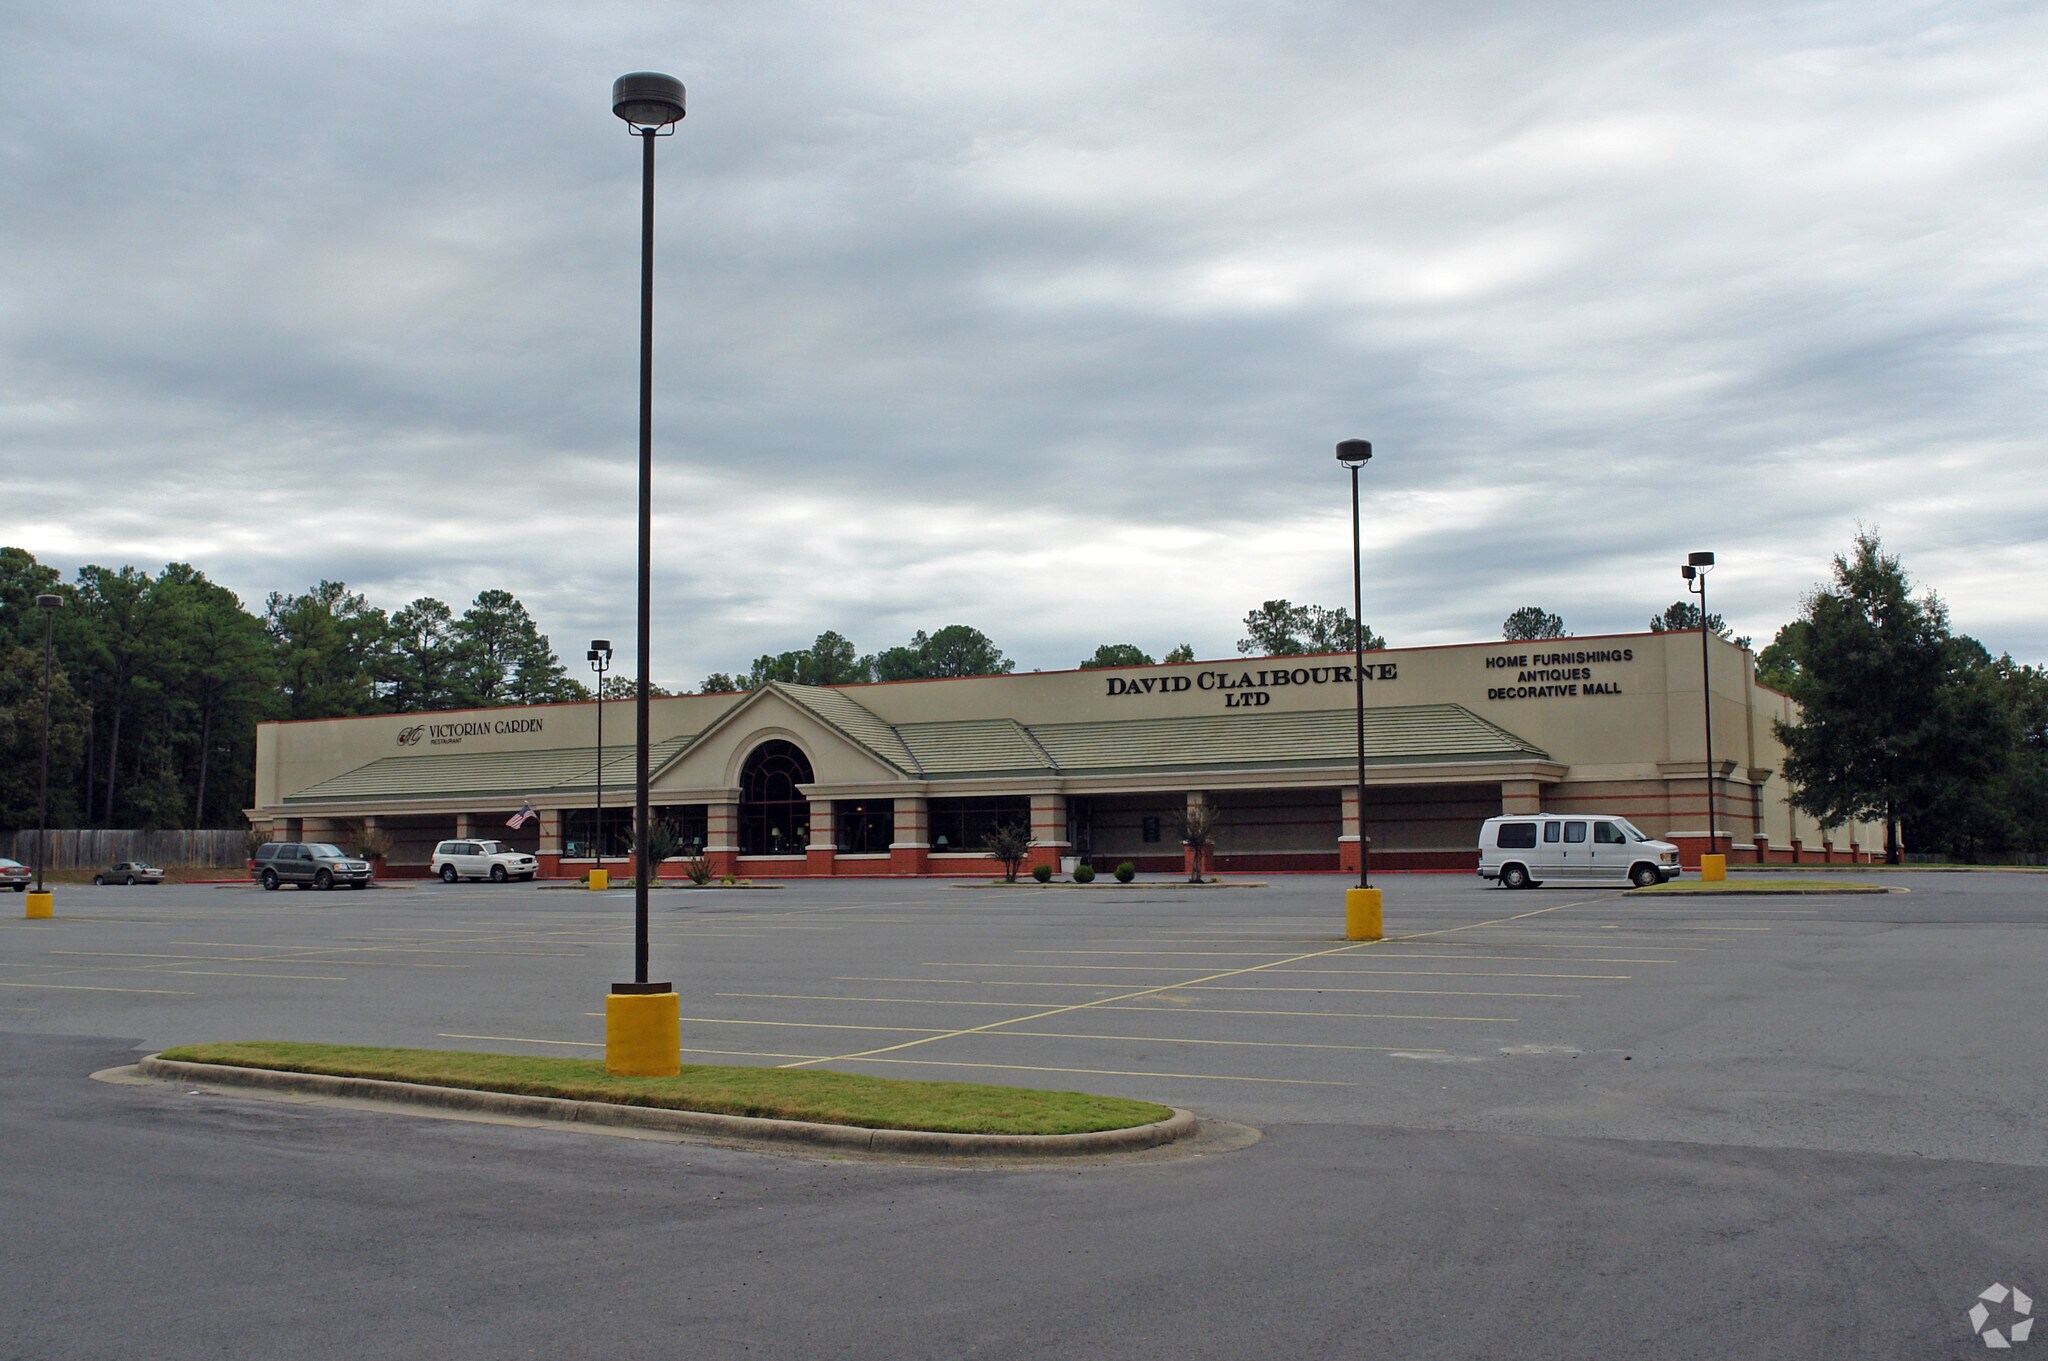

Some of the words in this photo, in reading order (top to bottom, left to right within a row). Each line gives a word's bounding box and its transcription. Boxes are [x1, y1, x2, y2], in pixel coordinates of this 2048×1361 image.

[1486, 655, 1527, 668] HOME
[1533, 649, 1633, 665] FURNISHINGS
[1106, 676, 1192, 696] DAVID
[1197, 663, 1398, 690] CLAIBOURNE
[1518, 668, 1591, 682] ANTIQUES
[1225, 691, 1270, 707] LTD
[1488, 685, 1577, 699] DECORATIVE
[1583, 682, 1622, 695] MALL
[429, 722, 491, 738] VICTORIAN
[495, 718, 543, 734] GARDEN
[430, 737, 462, 745] RESTAURANT
